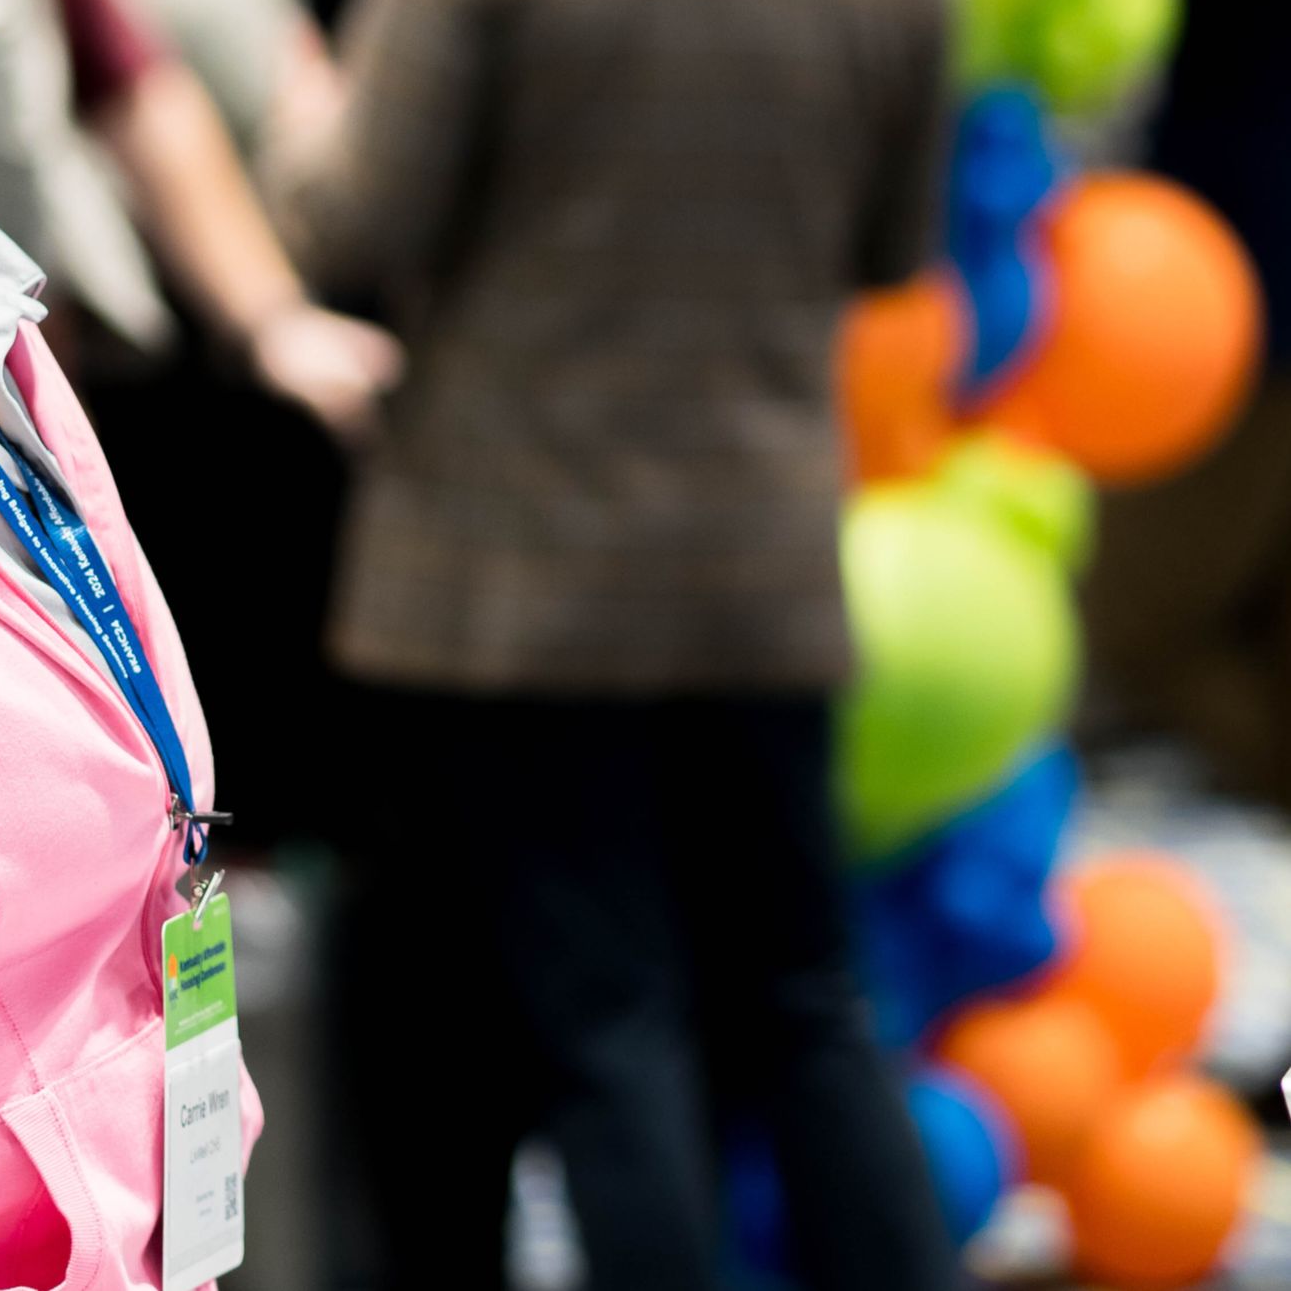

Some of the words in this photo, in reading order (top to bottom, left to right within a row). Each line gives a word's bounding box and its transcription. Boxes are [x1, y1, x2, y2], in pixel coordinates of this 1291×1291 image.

[8, 499, 34, 537] Bridges
[32, 536, 41, 548] to
[39, 547, 77, 595] Innovative
[75, 594, 103, 635] Housing
[84, 568, 106, 599] 2024
